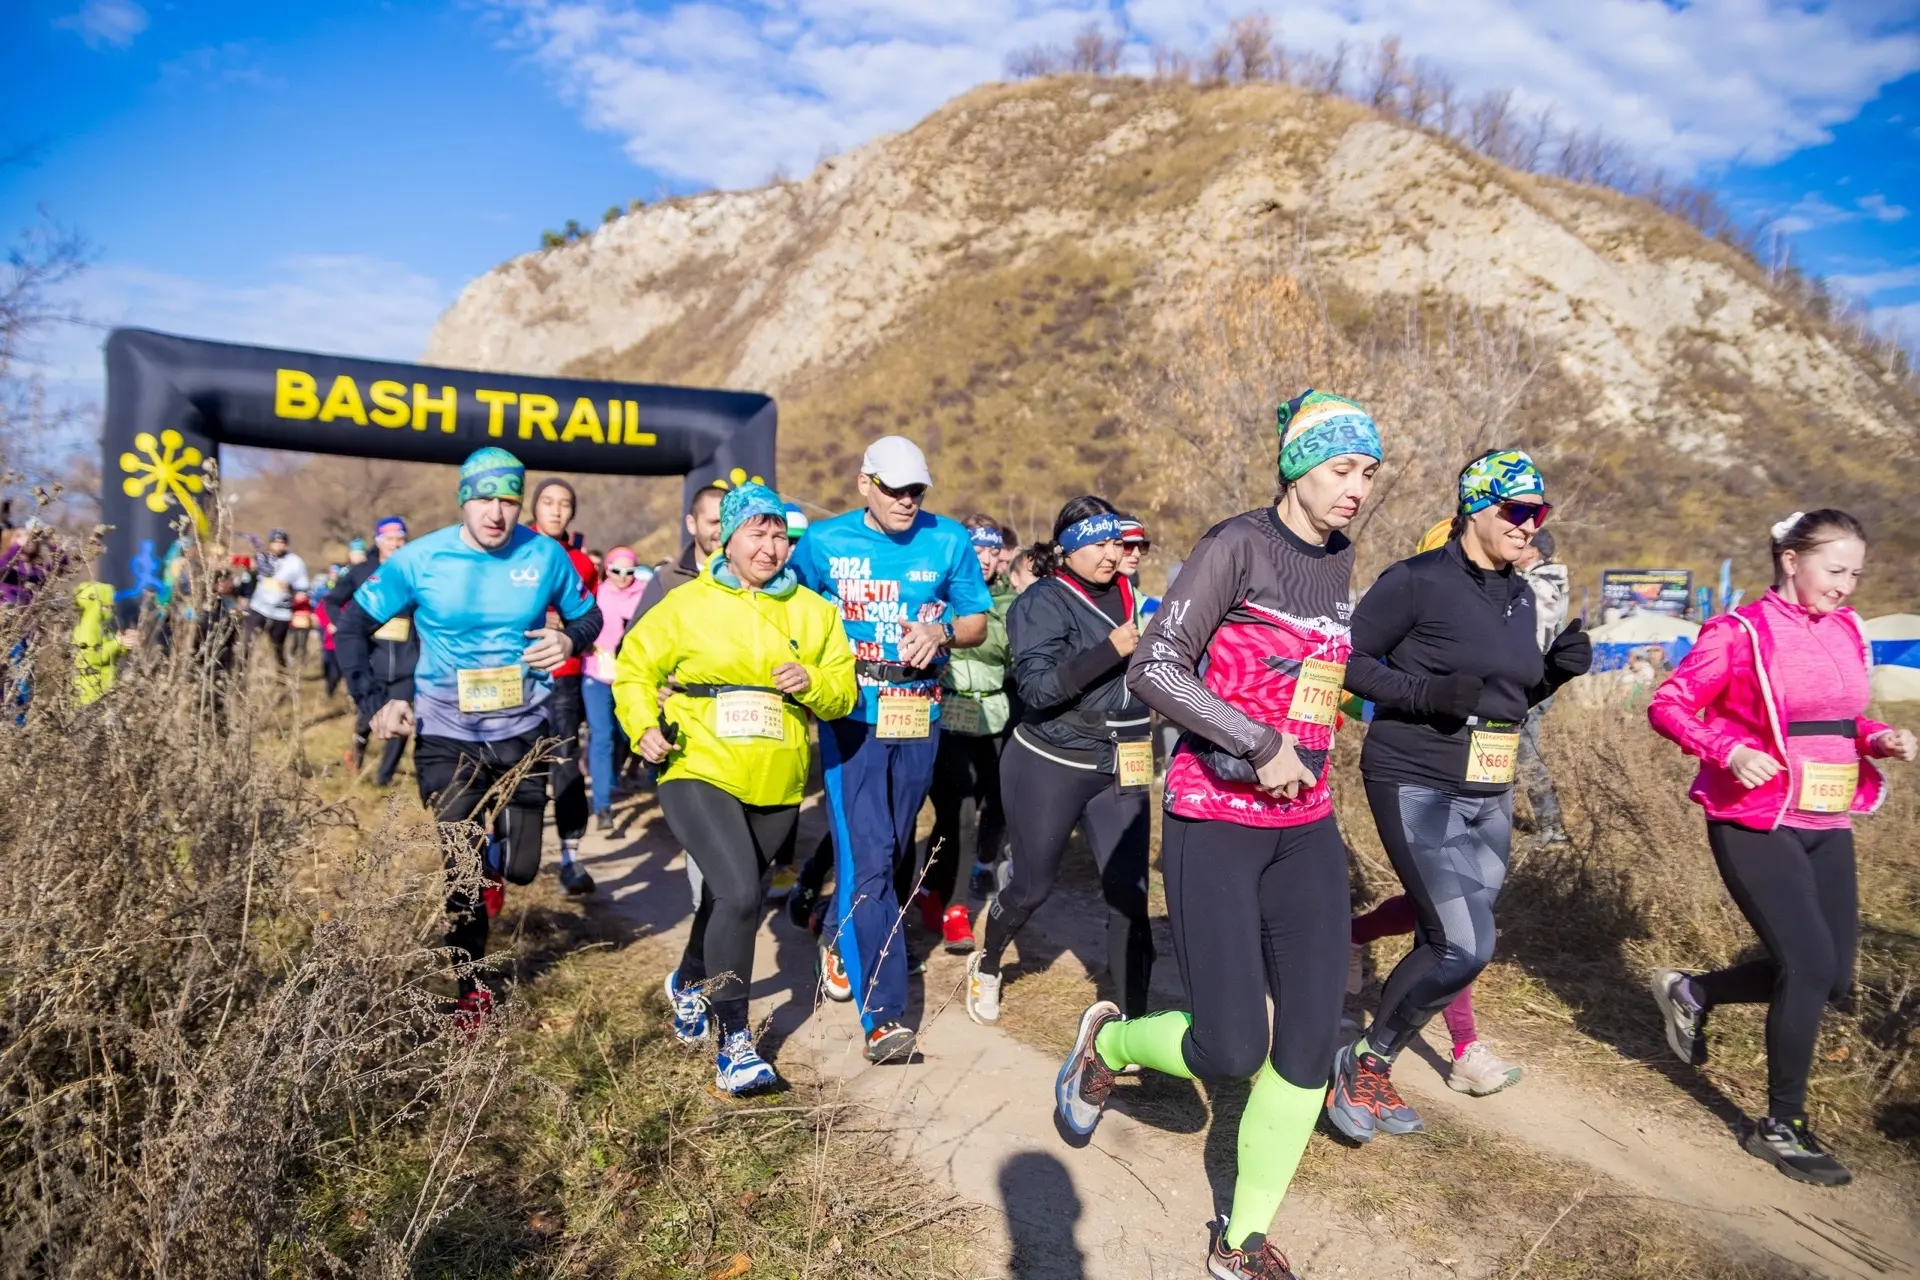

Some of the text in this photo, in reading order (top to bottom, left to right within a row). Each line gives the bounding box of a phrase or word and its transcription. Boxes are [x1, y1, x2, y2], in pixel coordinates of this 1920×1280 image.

[274, 368, 658, 447] BASH TRAIL
[1287, 424, 1359, 466] BASH
[829, 556, 872, 580] 2024
[836, 579, 899, 602] #МЕЧТА
[465, 685, 498, 699] 5038
[1302, 686, 1334, 707] 1716
[723, 709, 760, 722] 1626
[884, 714, 912, 726] 1715
[1125, 760, 1145, 773] 1632
[1477, 753, 1509, 768] 1668
[1810, 783, 1845, 797] 1653
